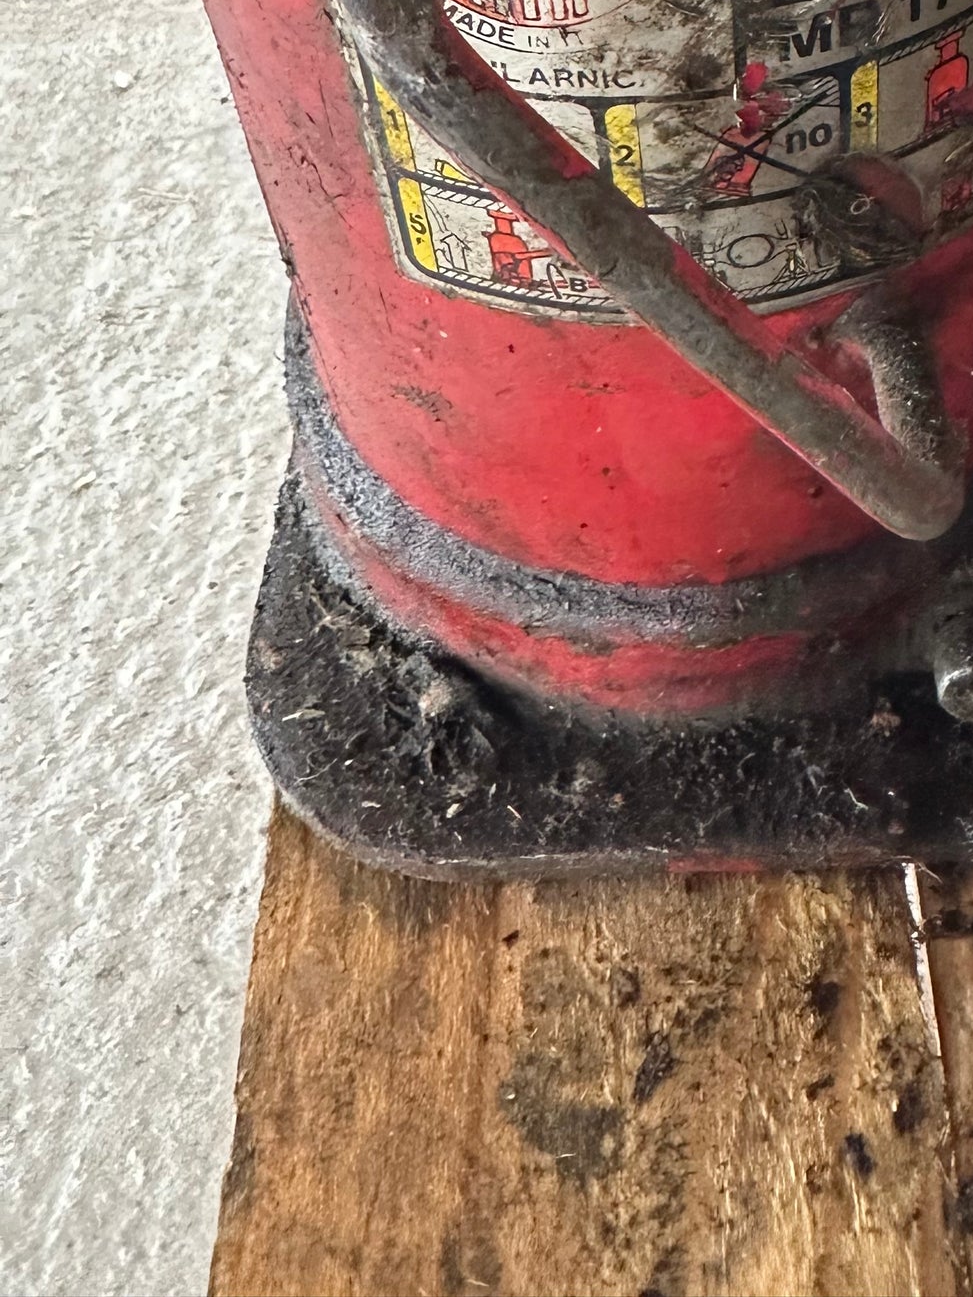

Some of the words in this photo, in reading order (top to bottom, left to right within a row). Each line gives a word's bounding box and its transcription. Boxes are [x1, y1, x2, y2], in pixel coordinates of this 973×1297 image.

[385, 107, 400, 132] 1
[854, 101, 873, 128] 3
[785, 122, 833, 154] no
[615, 144, 636, 168] 2
